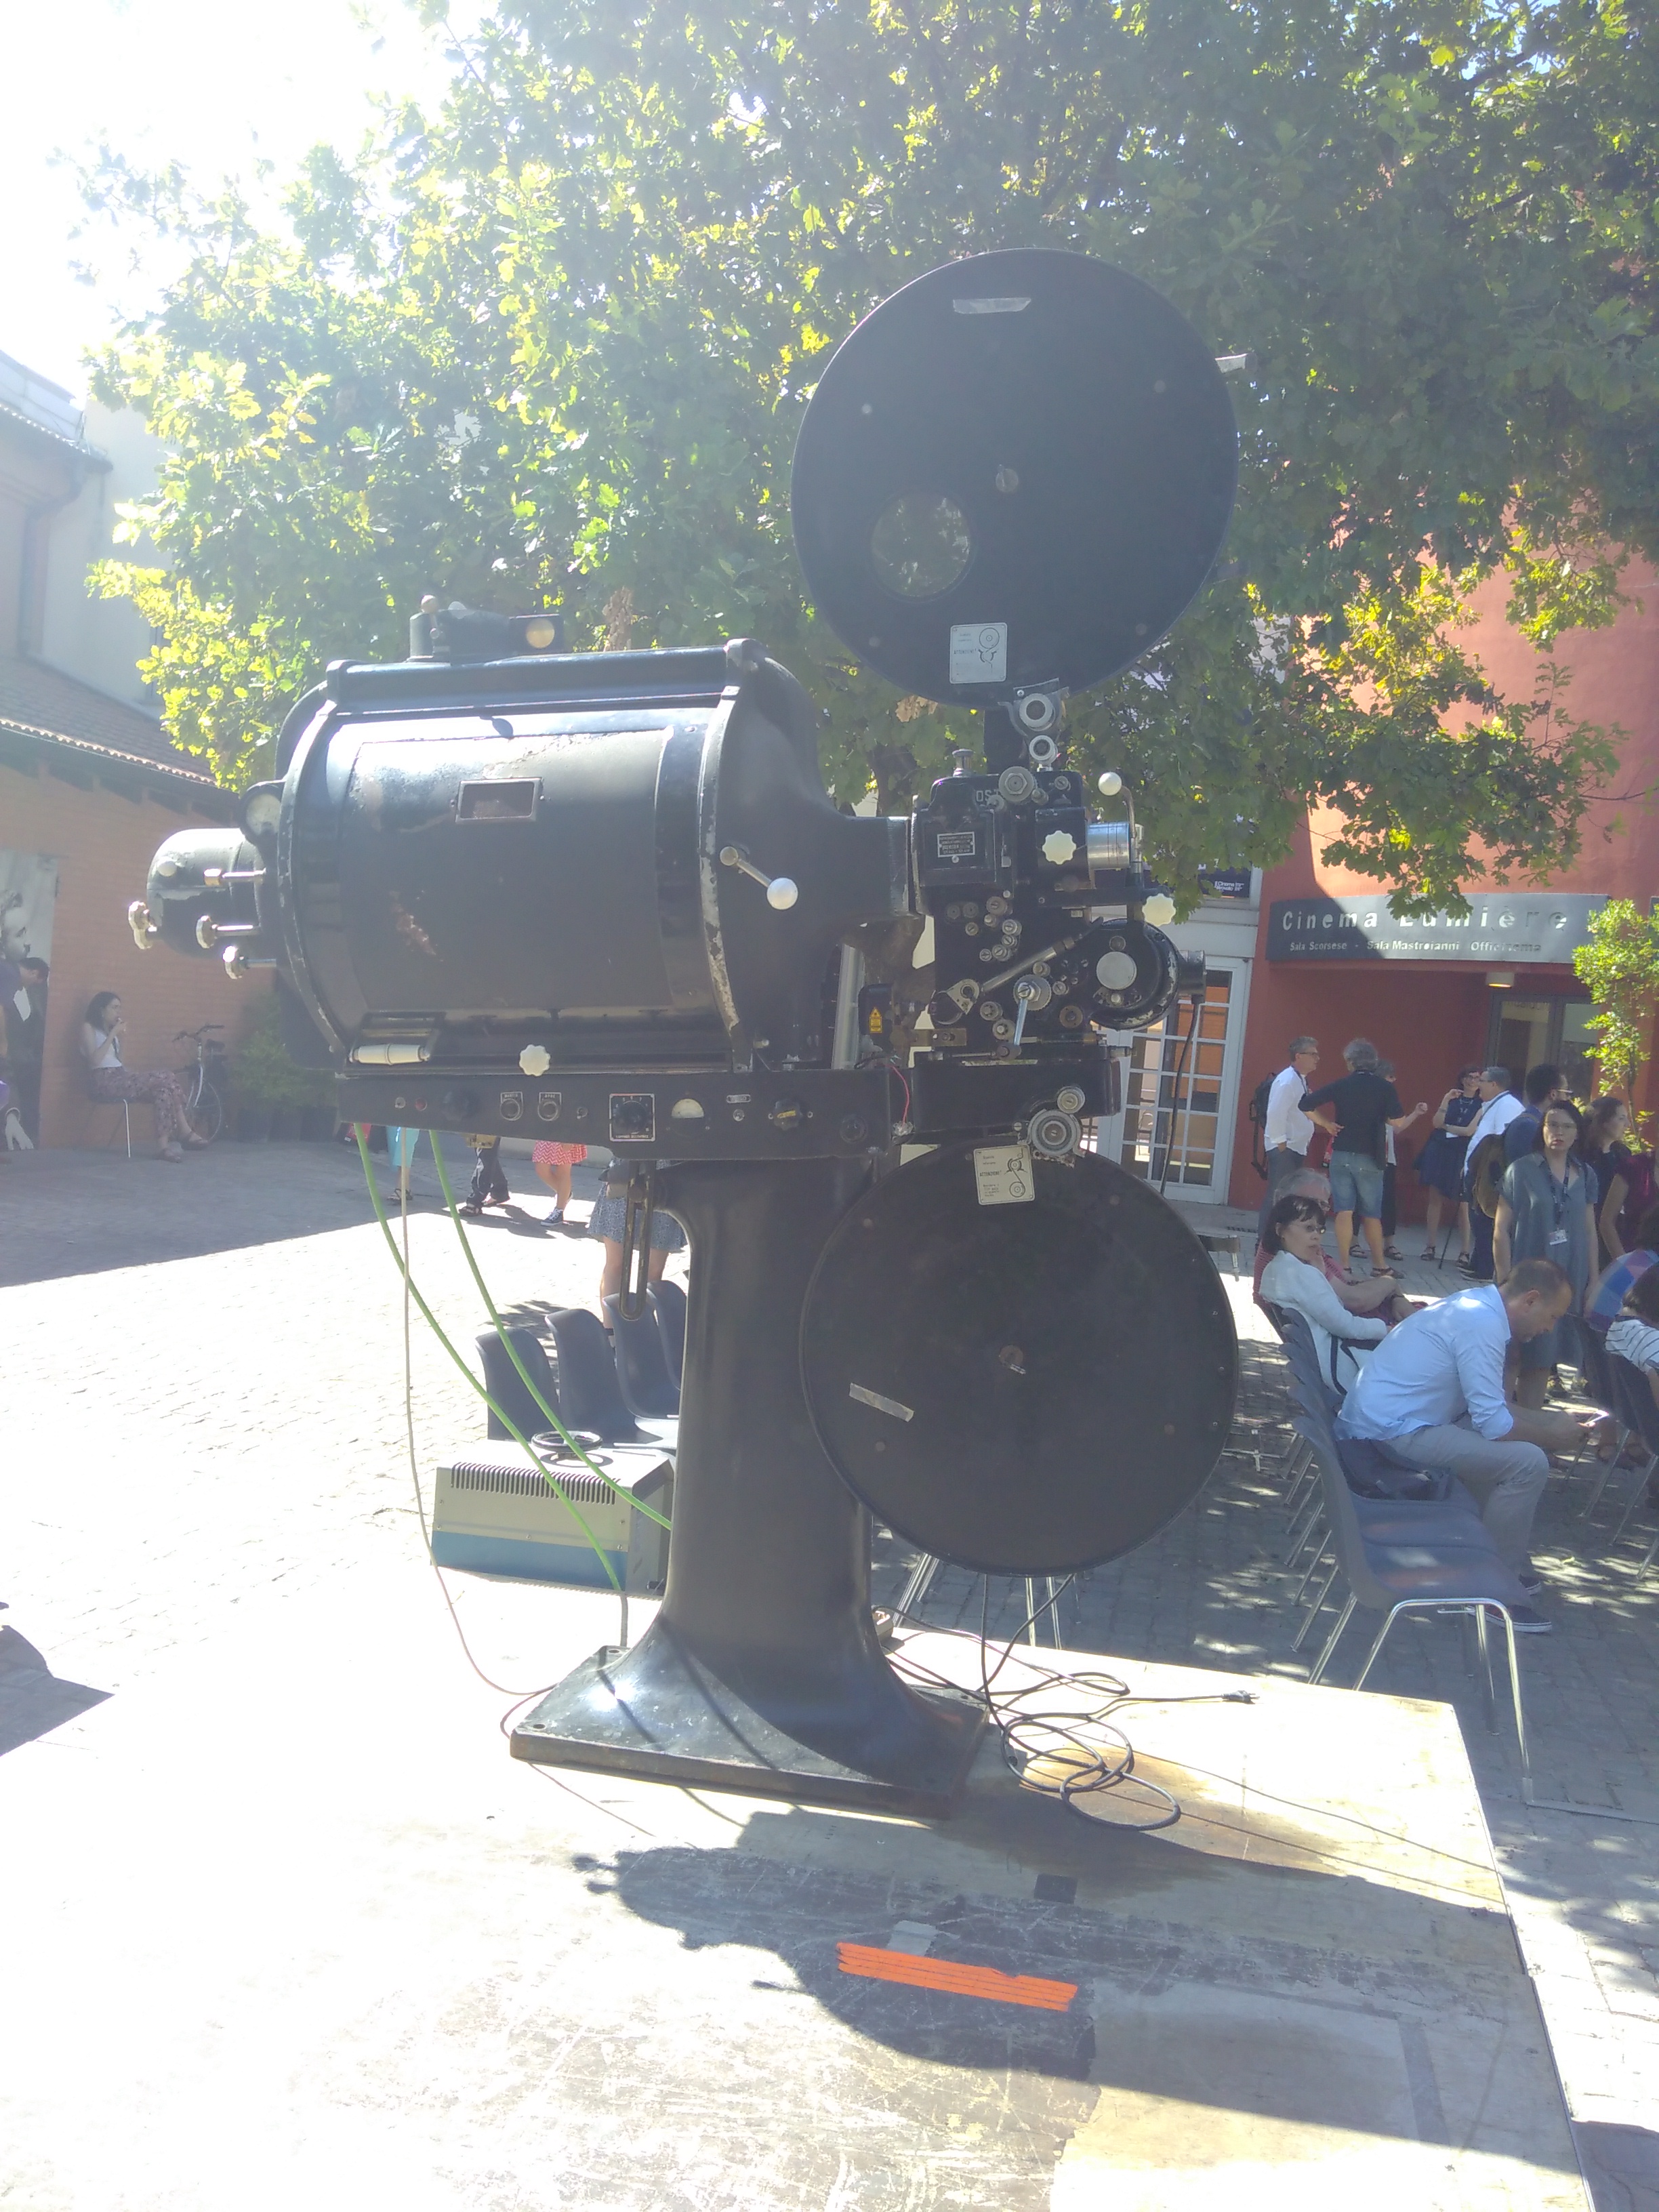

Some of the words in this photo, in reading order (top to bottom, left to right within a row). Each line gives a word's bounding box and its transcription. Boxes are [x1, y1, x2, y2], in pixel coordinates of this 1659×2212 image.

[1282, 911, 1378, 930] Cinema
[1290, 942, 1305, 951] Sala
[1309, 941, 1347, 950] Scorsese
[1367, 940, 1389, 950] Sala
[1392, 940, 1459, 951] Mastroianni
